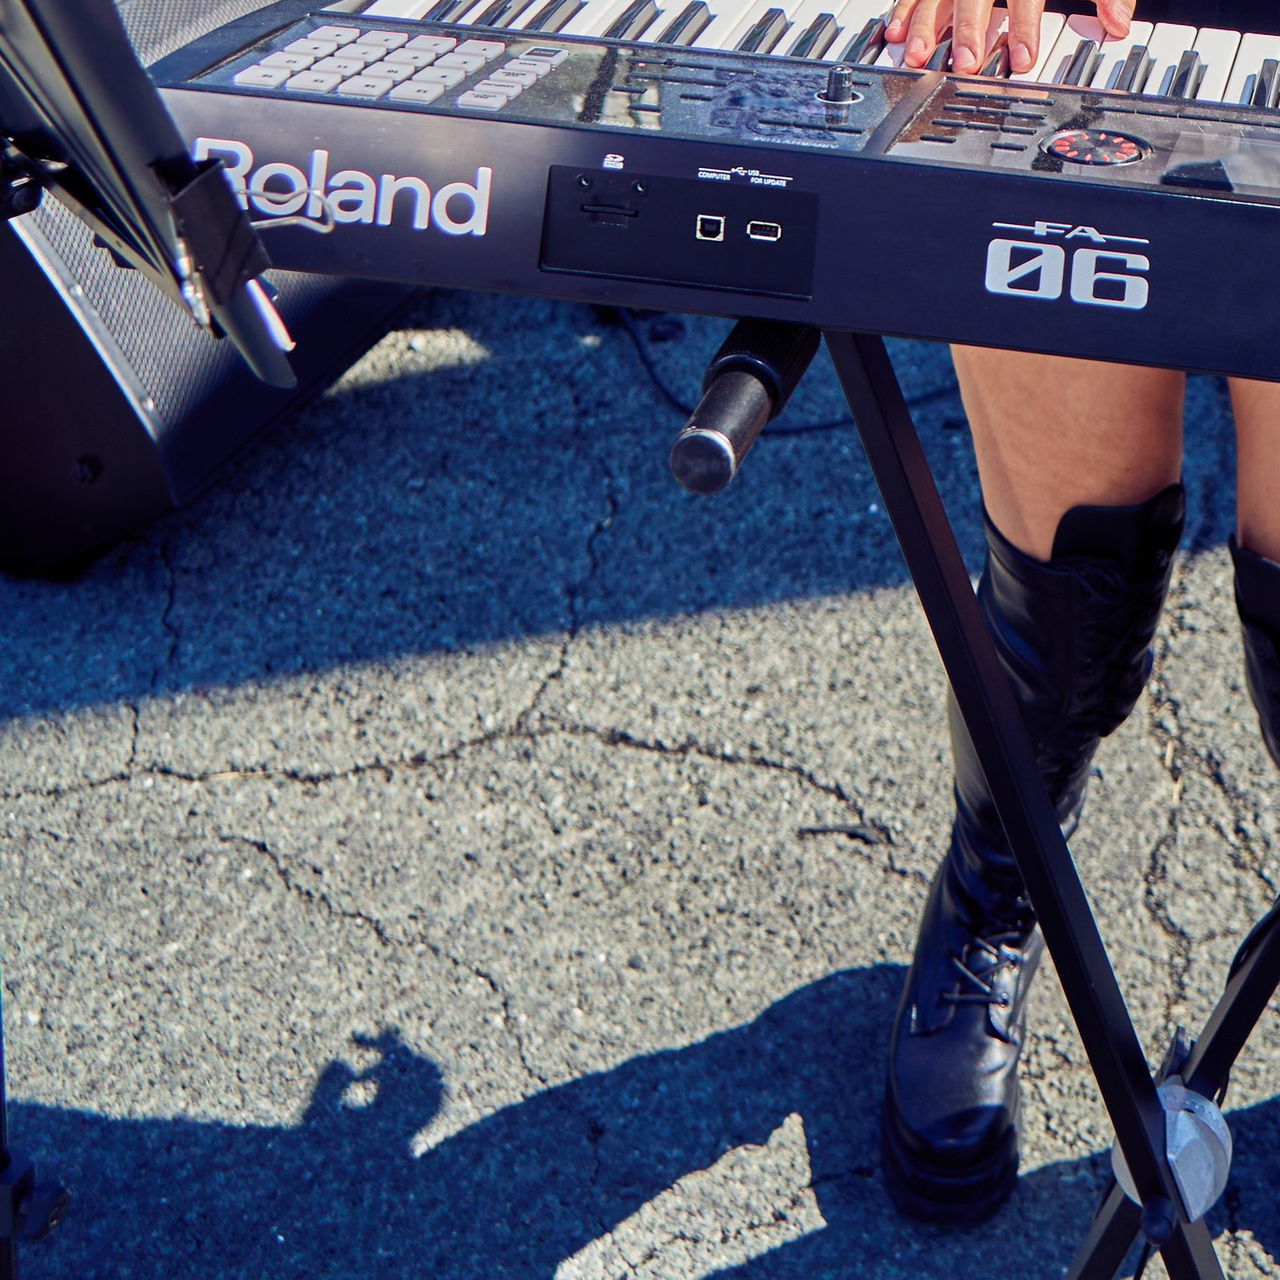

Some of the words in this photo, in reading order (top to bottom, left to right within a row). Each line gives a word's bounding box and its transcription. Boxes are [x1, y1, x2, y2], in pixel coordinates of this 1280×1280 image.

[192, 136, 493, 236] Roland
[698, 171, 731, 181] COMPUTER
[763, 178, 787, 187] UPDATE
[1033, 220, 1107, 243] FA
[984, 237, 1150, 310] 06
